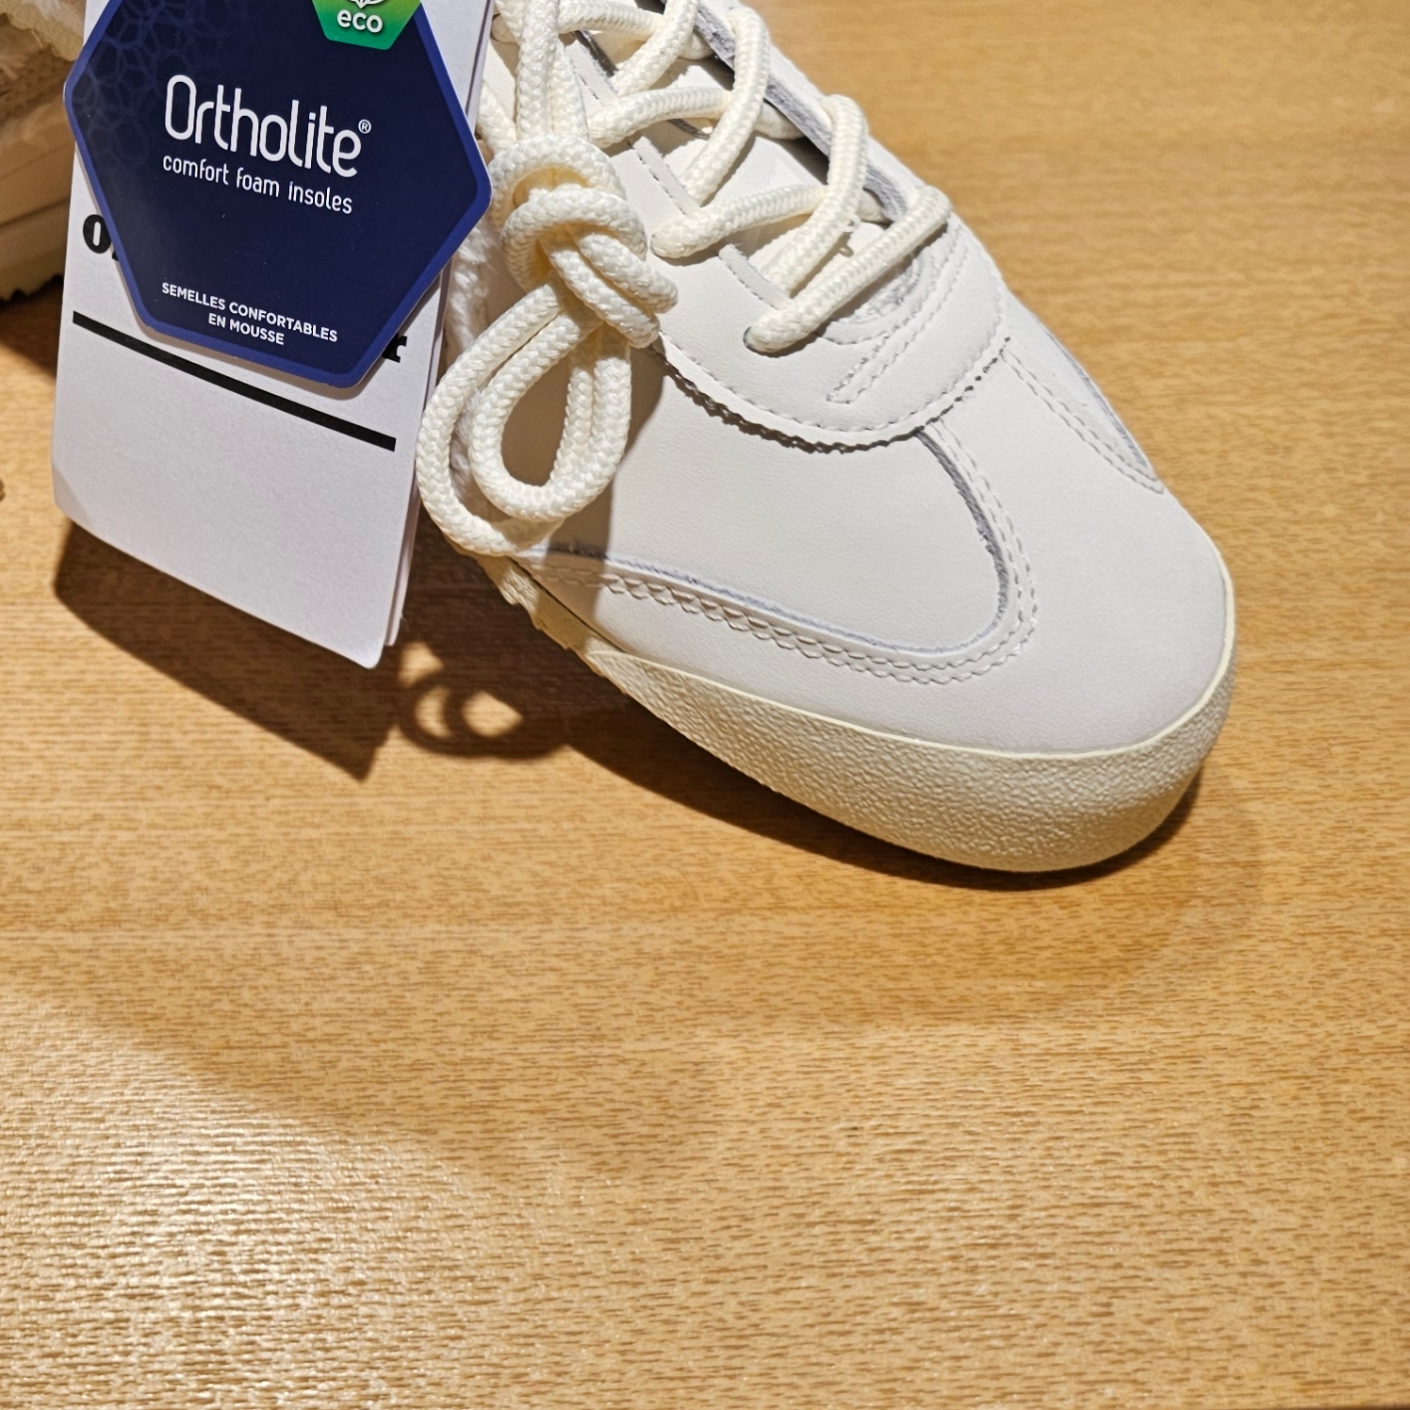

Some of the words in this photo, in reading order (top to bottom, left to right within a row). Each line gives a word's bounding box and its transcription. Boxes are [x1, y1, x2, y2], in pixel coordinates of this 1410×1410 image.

[337, 9, 383, 33] eco
[162, 155, 229, 186] comfort
[236, 167, 280, 198] foam
[287, 181, 353, 215] insoles
[161, 282, 226, 310] SEMELLES
[228, 301, 338, 343] CONFORTABLES
[208, 312, 226, 328] EN
[229, 318, 285, 346] MOUSSE
